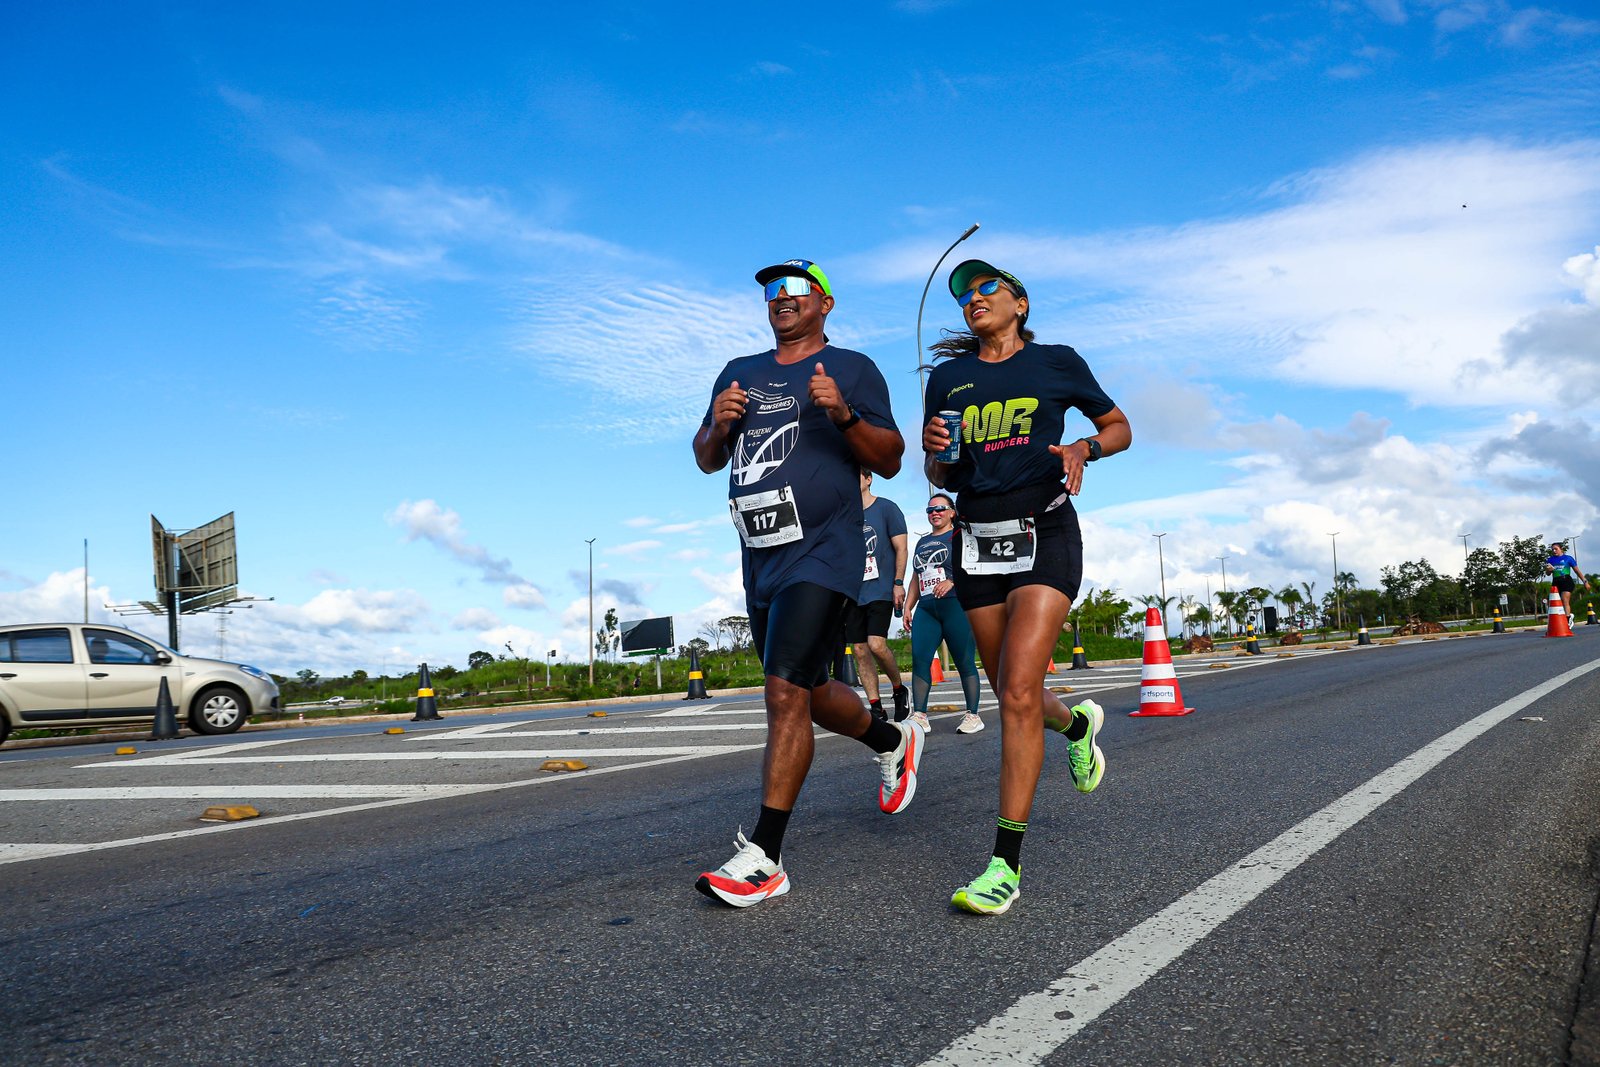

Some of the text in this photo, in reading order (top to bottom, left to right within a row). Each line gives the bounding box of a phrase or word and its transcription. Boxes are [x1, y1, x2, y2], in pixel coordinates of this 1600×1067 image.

[759, 400, 791, 411] RUNSERIES
[962, 397, 1039, 444] MR
[984, 437, 1030, 453] RUNNERS
[753, 511, 777, 531] 117
[990, 541, 1015, 557] 42
[1147, 690, 1173, 698] tfsports
